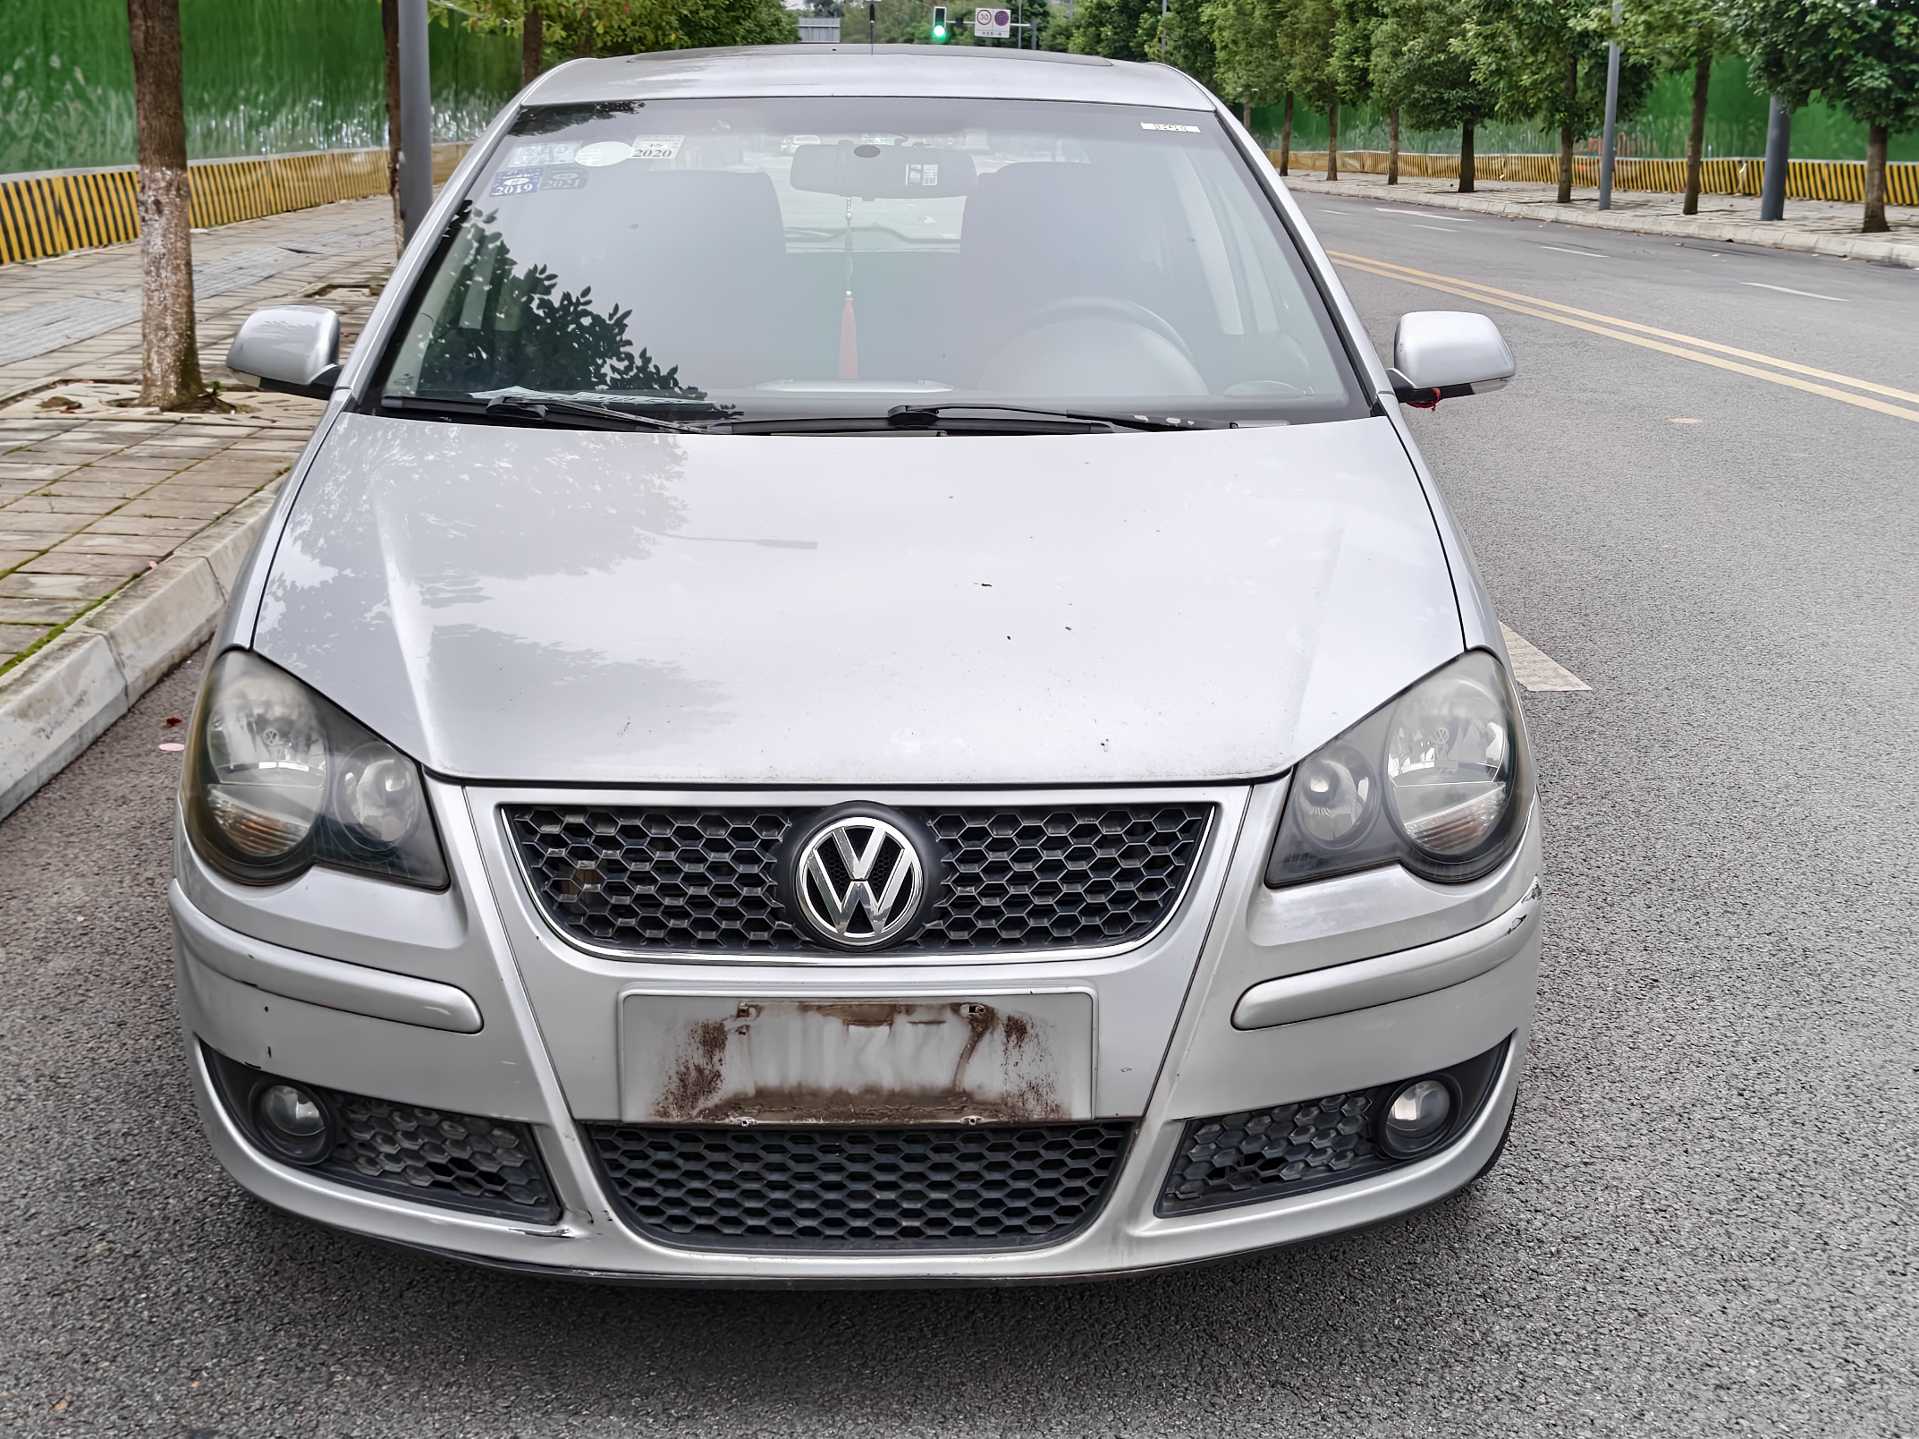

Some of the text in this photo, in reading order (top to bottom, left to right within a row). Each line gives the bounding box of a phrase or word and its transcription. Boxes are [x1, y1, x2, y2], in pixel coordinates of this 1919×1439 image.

[632, 148, 672, 159] 2020
[494, 183, 533, 195] 2019
[799, 819, 921, 943] VW
